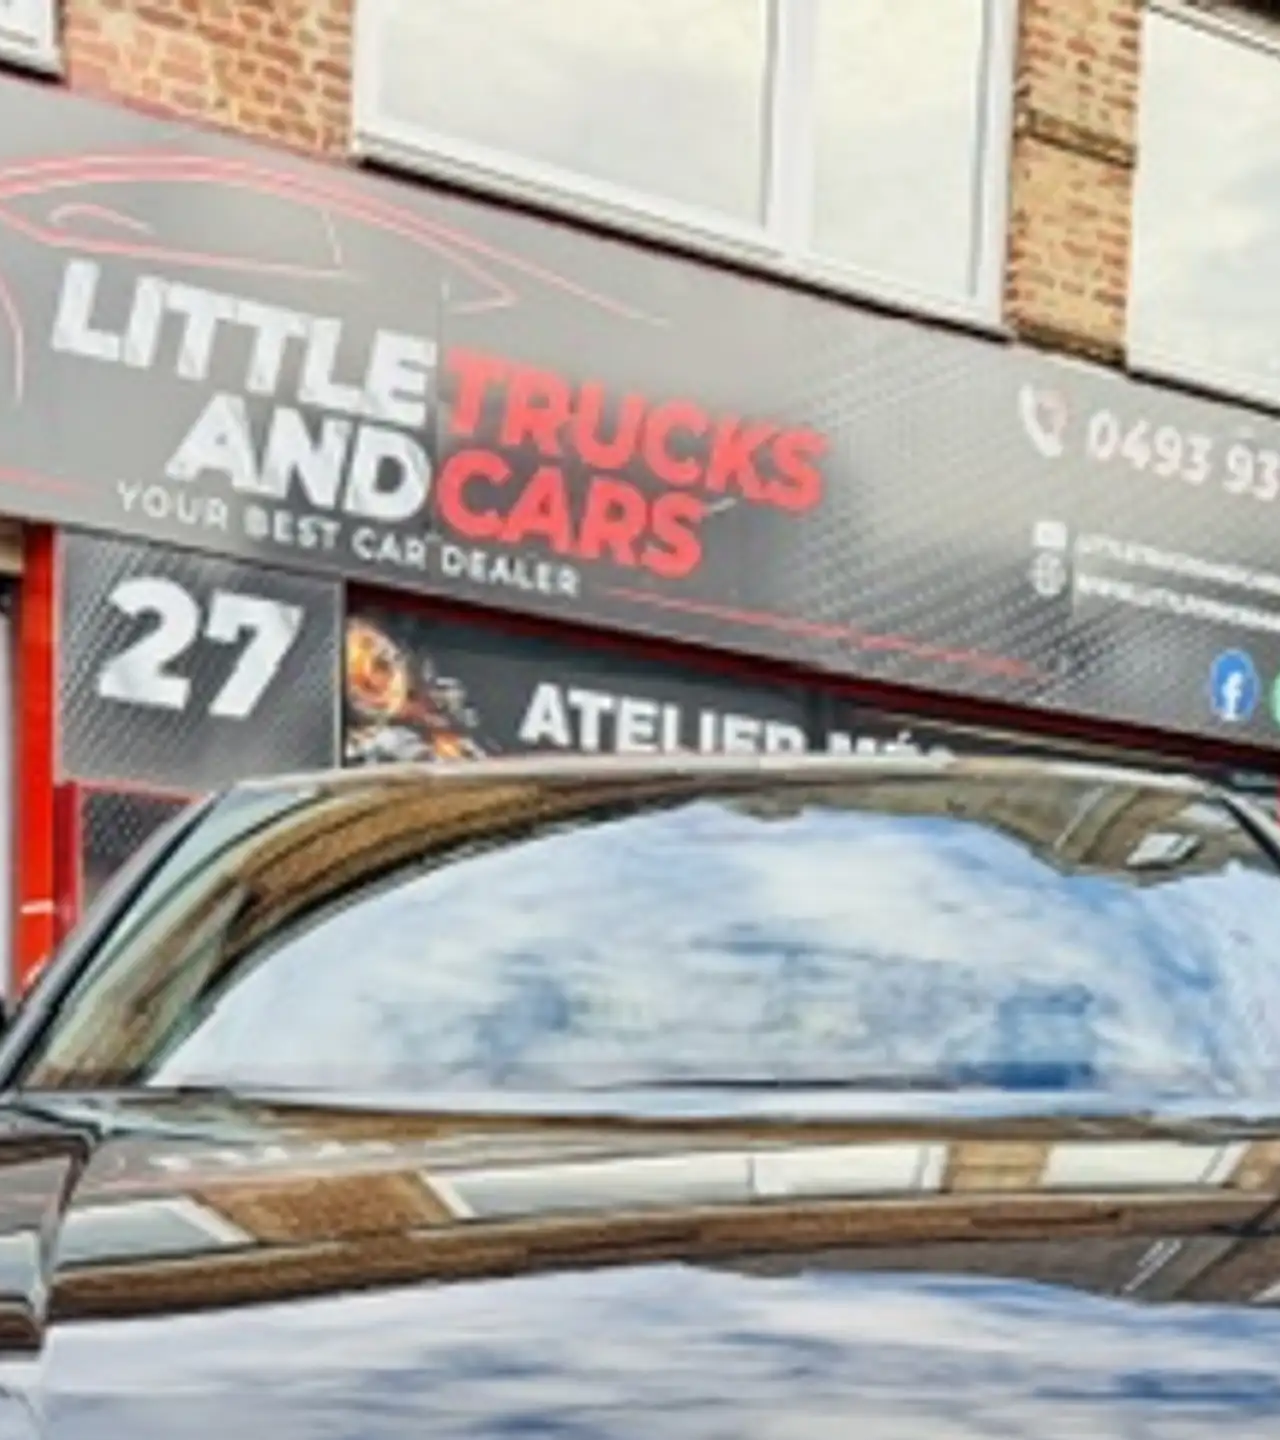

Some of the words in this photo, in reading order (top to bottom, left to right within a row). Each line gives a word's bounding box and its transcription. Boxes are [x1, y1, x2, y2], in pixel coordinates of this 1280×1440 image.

[51, 258, 438, 427] LITTLE
[445, 346, 832, 513] TRUCKS
[1087, 408, 1214, 485] 0493
[116, 478, 230, 532] YOUR
[243, 505, 341, 551] BEST
[351, 527, 429, 573] CAR
[439, 543, 582, 598] DEALER
[165, 393, 432, 522] AND
[436, 448, 706, 580] CARS
[98, 576, 306, 719] 27
